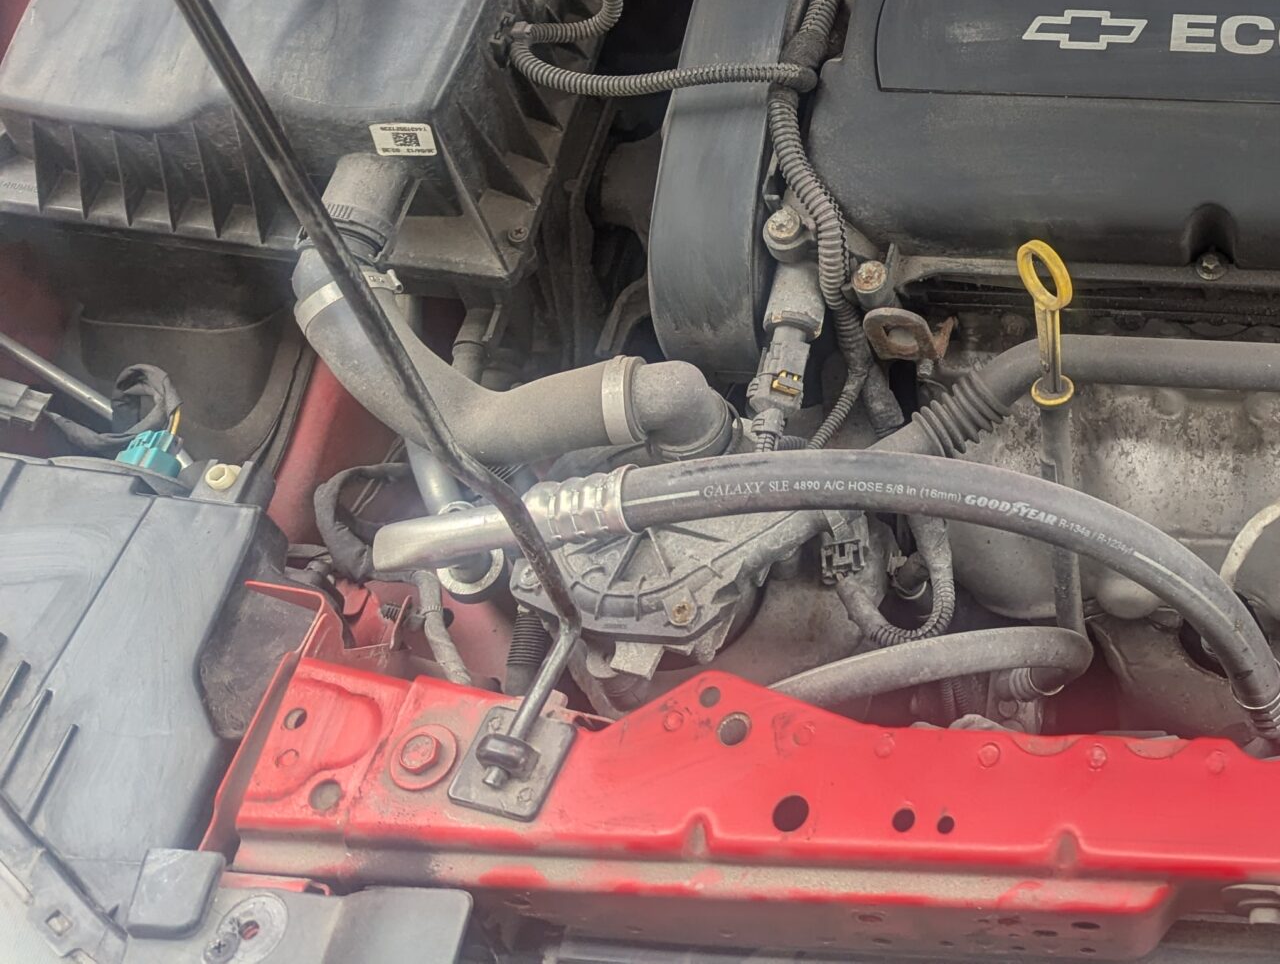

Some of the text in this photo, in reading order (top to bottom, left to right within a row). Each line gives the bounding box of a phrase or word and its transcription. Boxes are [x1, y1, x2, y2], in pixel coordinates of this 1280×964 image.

[703, 483, 763, 497] GALAXY
[768, 480, 790, 492] SLE
[793, 480, 820, 491] 4890
[824, 480, 844, 491] A/C
[848, 482, 883, 493] HOSE
[885, 483, 904, 495] 5/8
[906, 485, 917, 495] in
[919, 487, 962, 503] (16mm)
[964, 494, 1058, 526] GOODYEAR
[1057, 518, 1091, 538] R-134a
